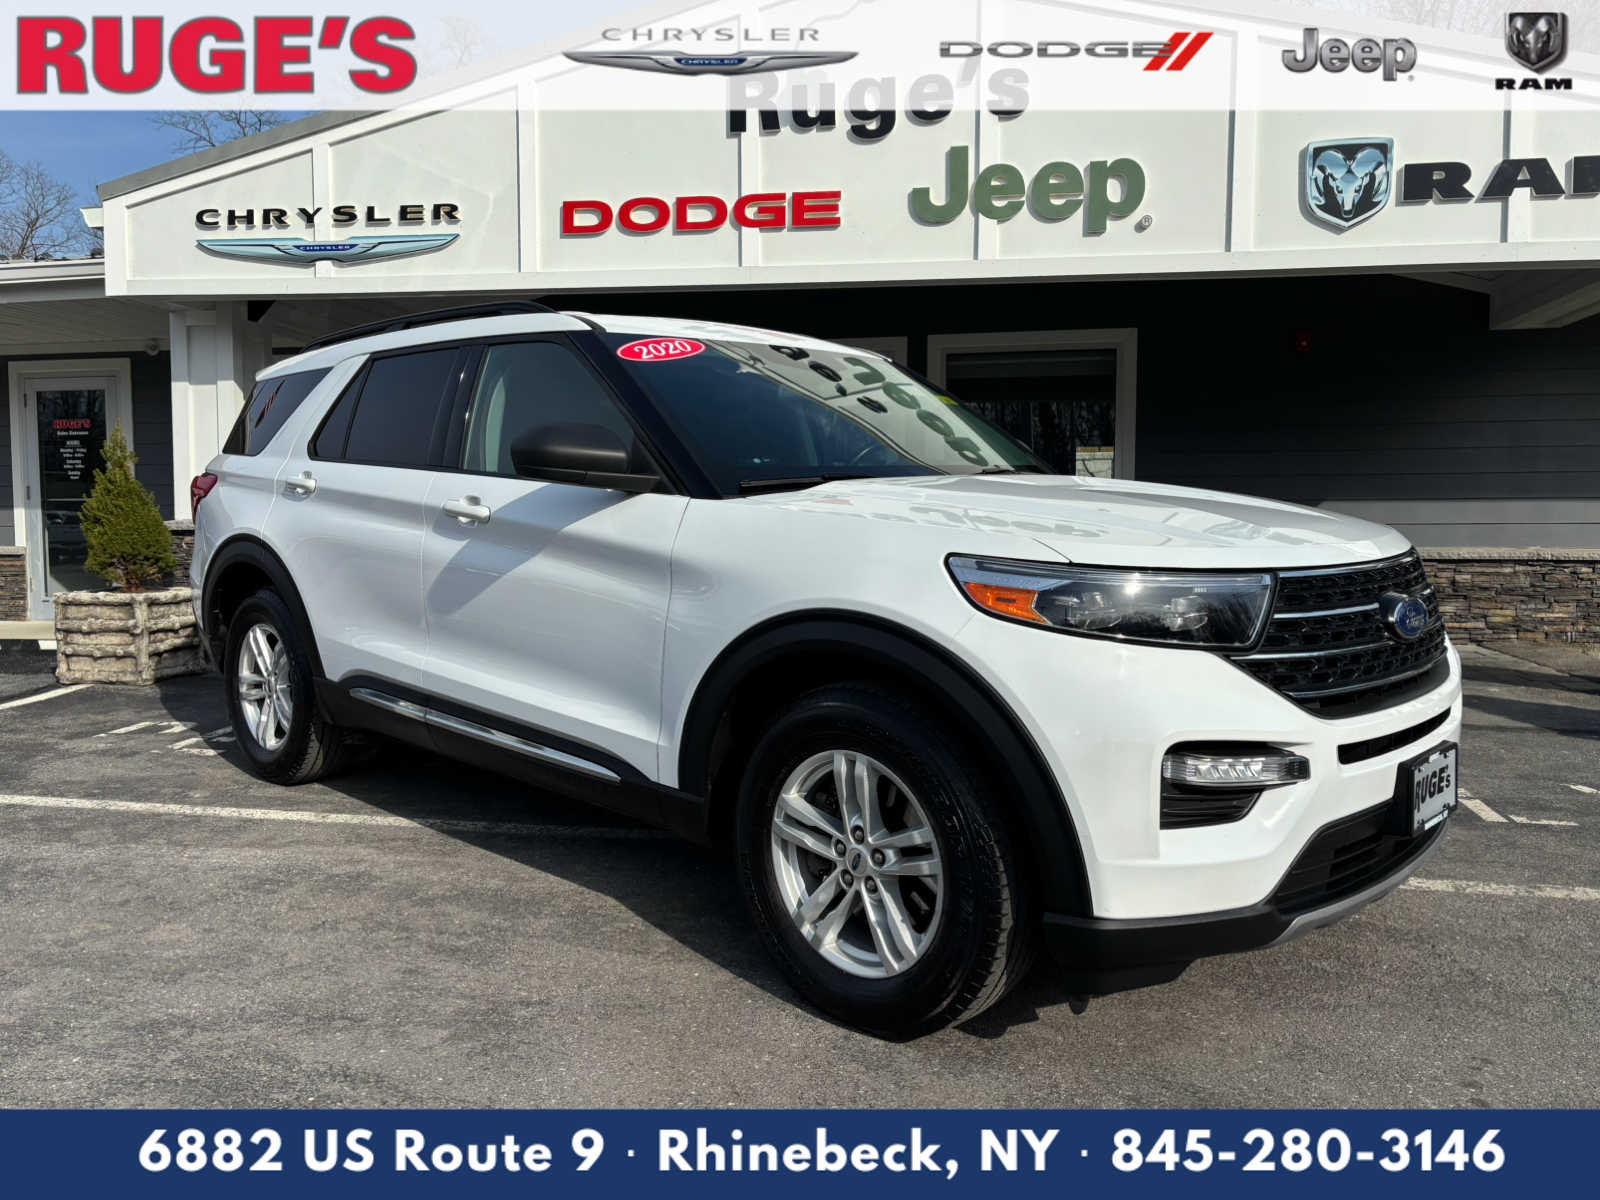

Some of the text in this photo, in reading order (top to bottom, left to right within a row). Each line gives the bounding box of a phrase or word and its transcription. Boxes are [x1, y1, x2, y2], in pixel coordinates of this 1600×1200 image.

[729, 56, 1030, 140] Ruge's
[561, 190, 842, 235] DODGE
[908, 145, 1146, 236] Jeep
[195, 202, 461, 228] CHRYSLER
[633, 339, 692, 360] 2020
